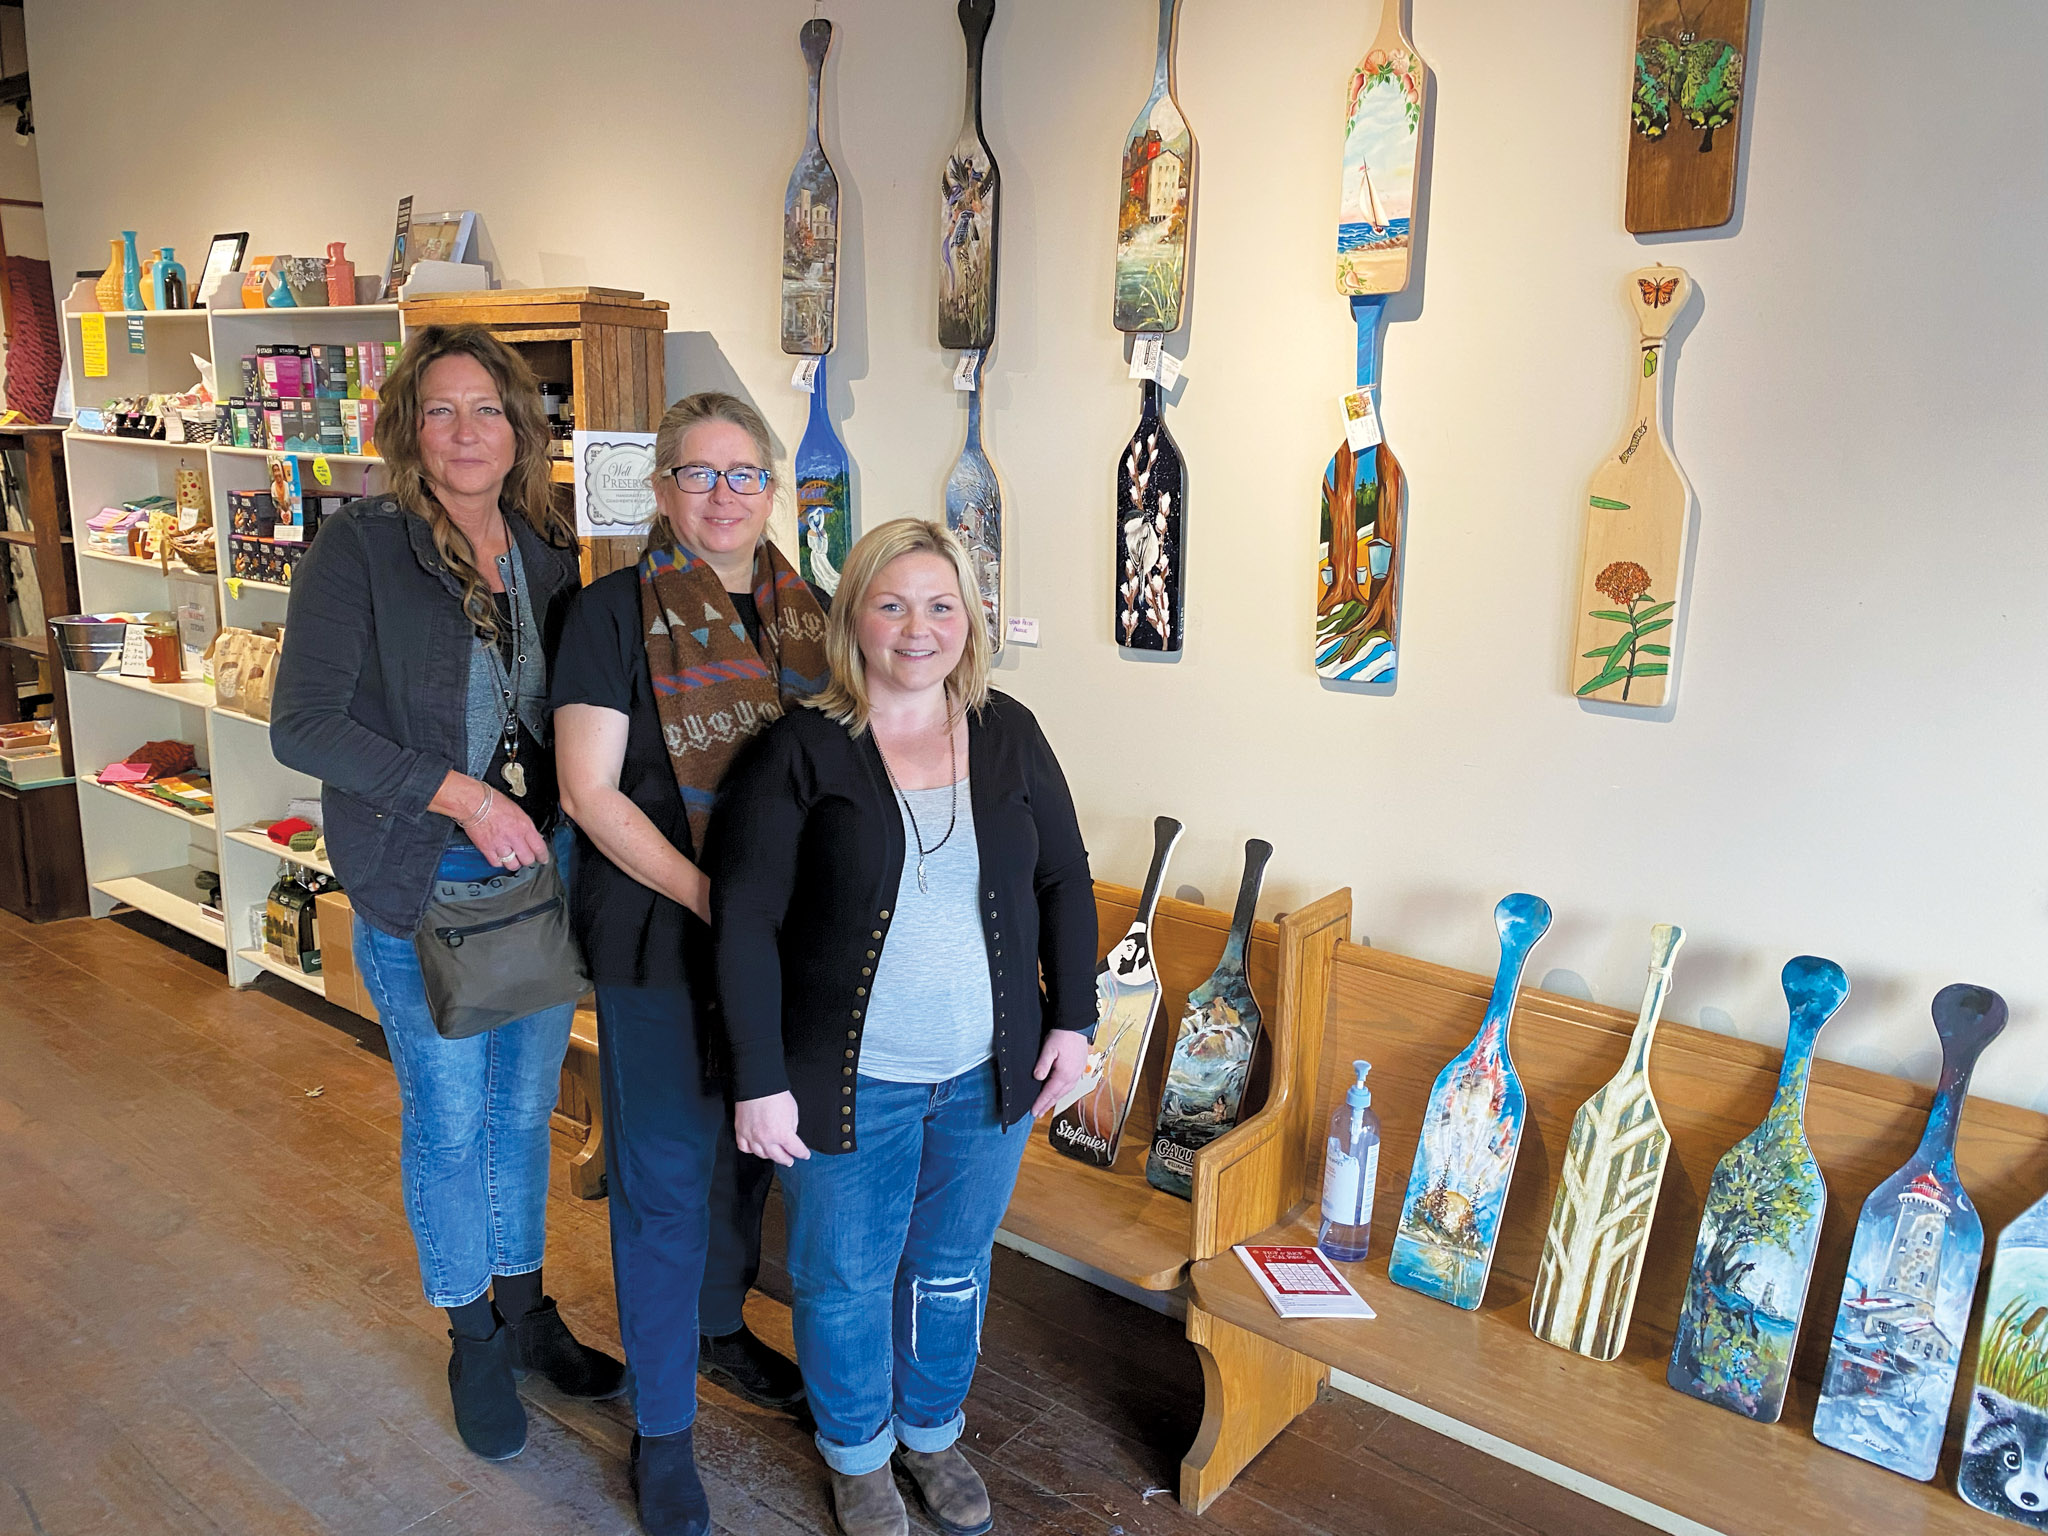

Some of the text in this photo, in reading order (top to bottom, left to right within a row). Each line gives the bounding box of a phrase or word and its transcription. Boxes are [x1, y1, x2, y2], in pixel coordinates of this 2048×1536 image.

[608, 461, 632, 477] Well
[602, 474, 645, 489] PRESERV
[1056, 1119, 1107, 1151] Stefanie's
[1156, 1139, 1195, 1163] GALL
